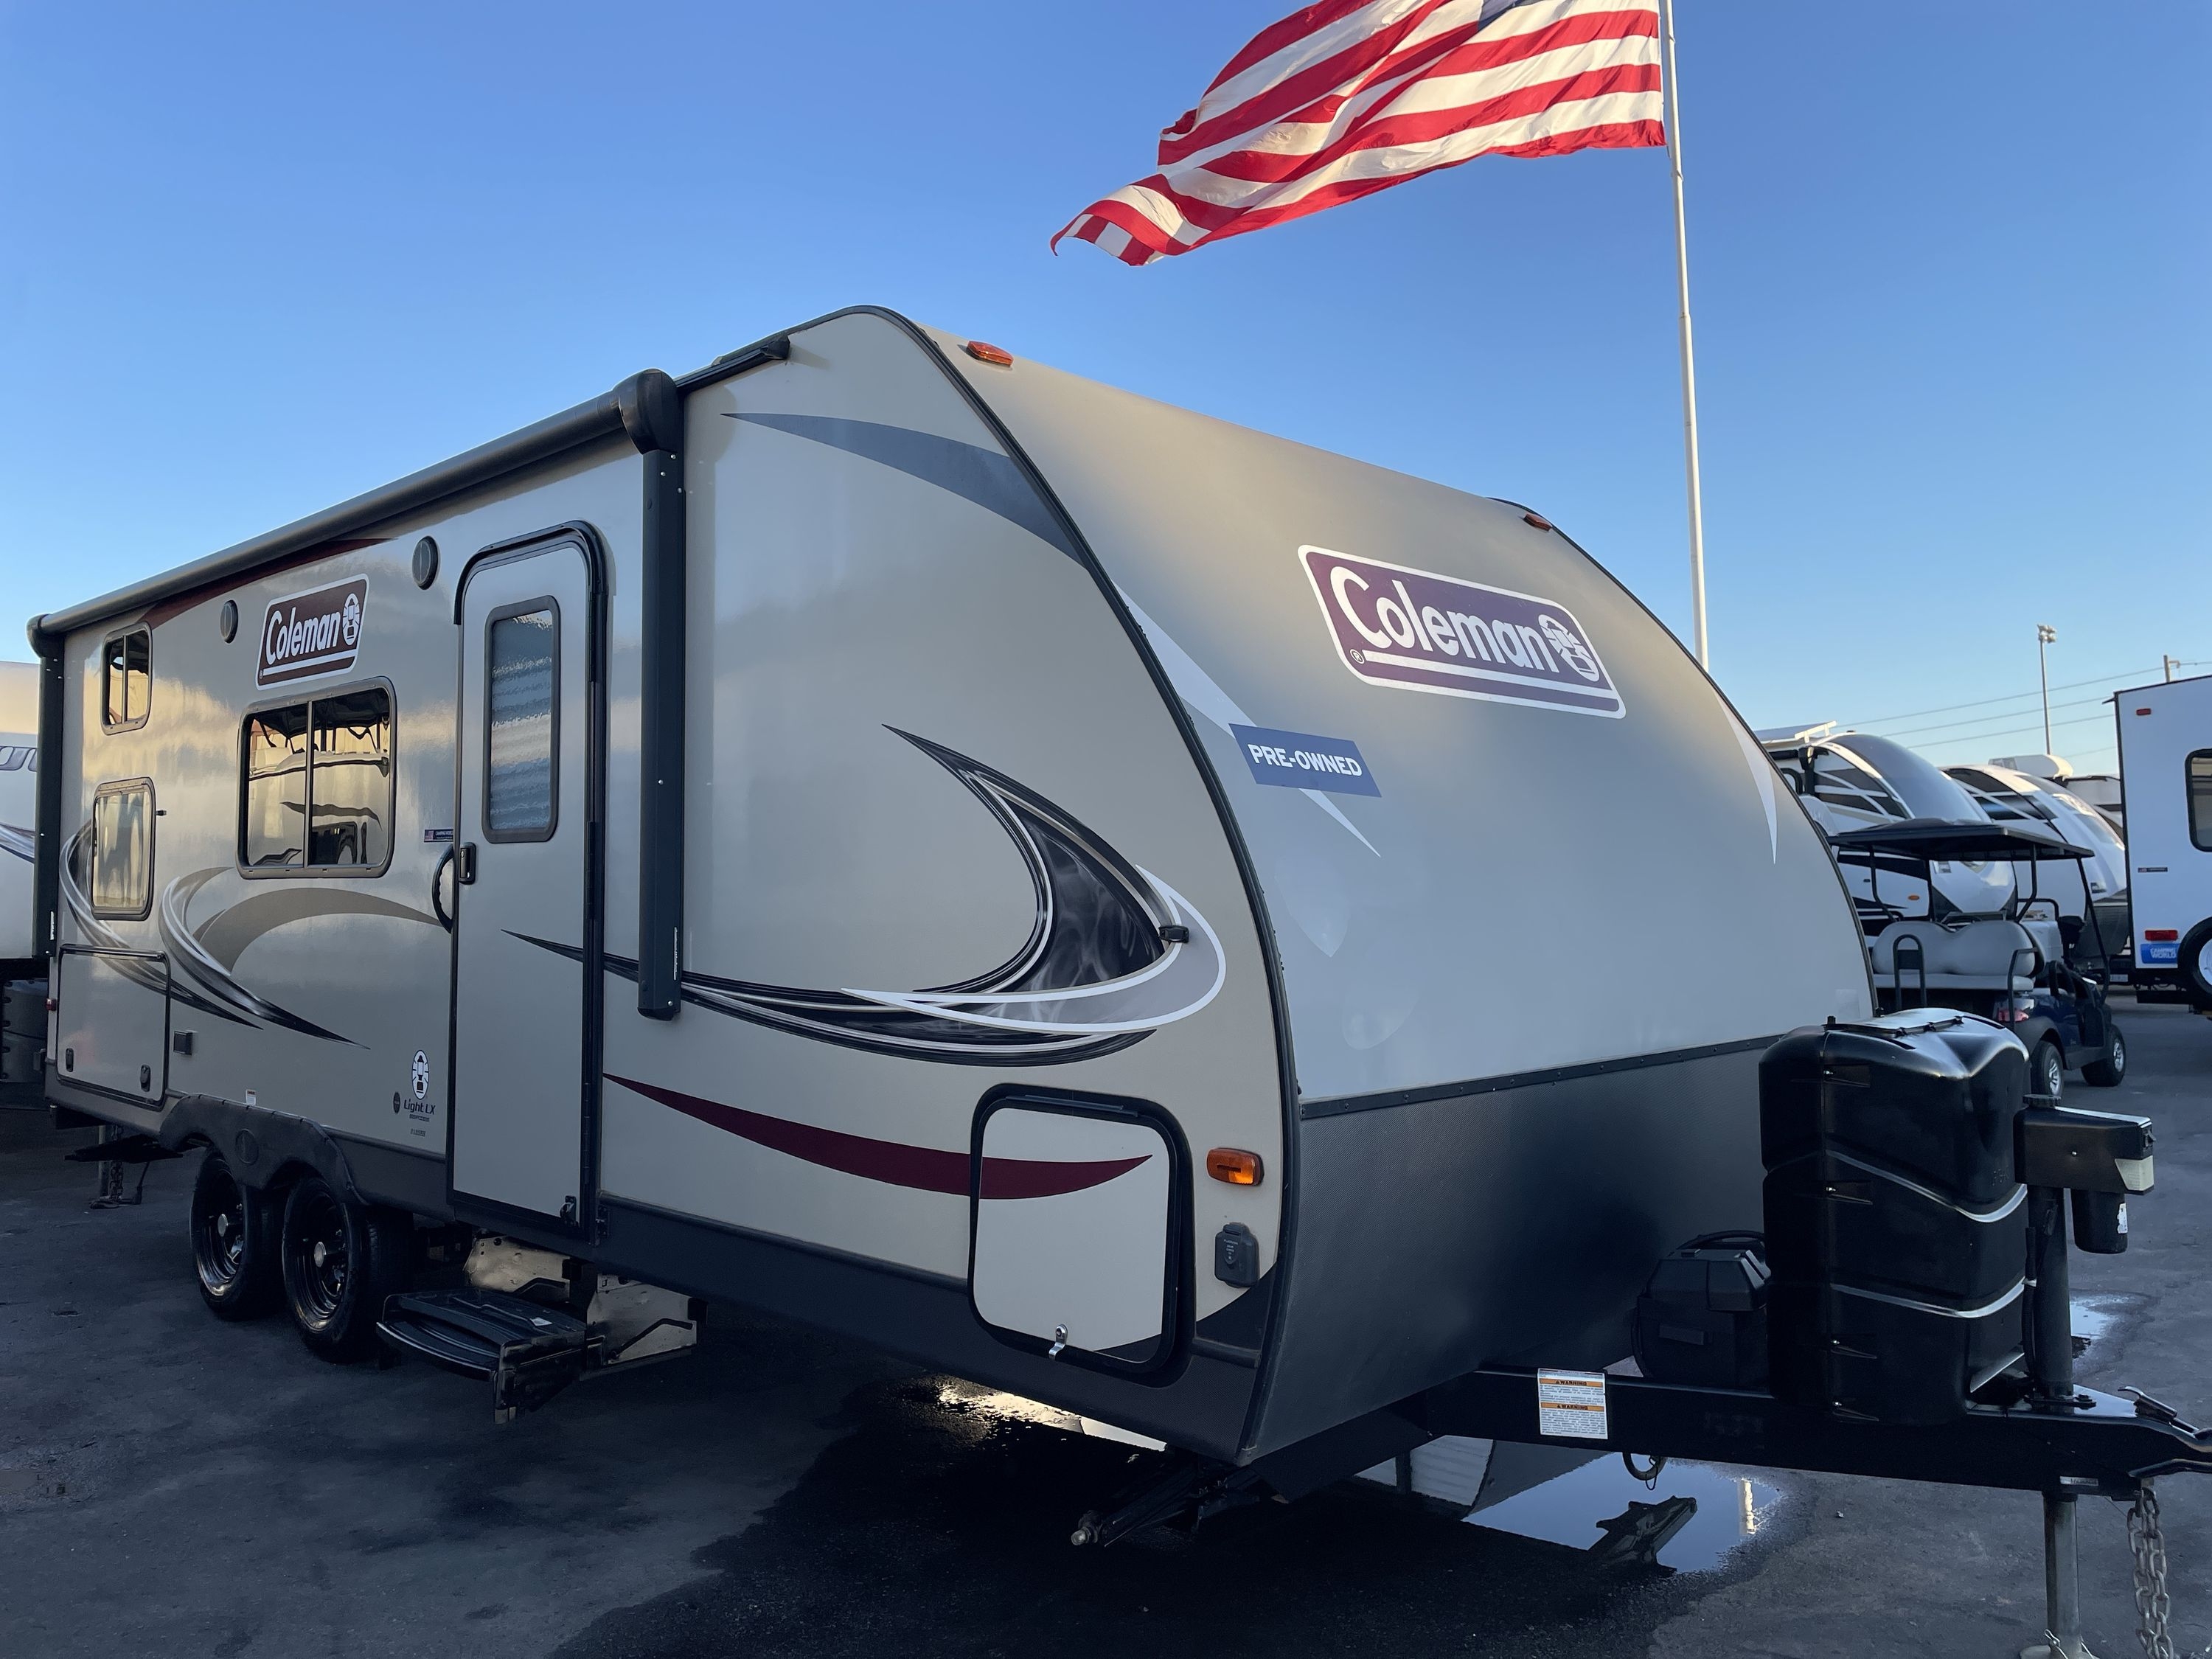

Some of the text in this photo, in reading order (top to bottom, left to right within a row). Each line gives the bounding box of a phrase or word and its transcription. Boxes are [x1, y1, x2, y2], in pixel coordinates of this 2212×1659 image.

[265, 607, 341, 665] Coleman
[1329, 566, 1559, 673] Coleman
[1247, 743, 1363, 776] PRE-OWNED
[403, 1099, 424, 1113] Light
[425, 1103, 436, 1115] LX
